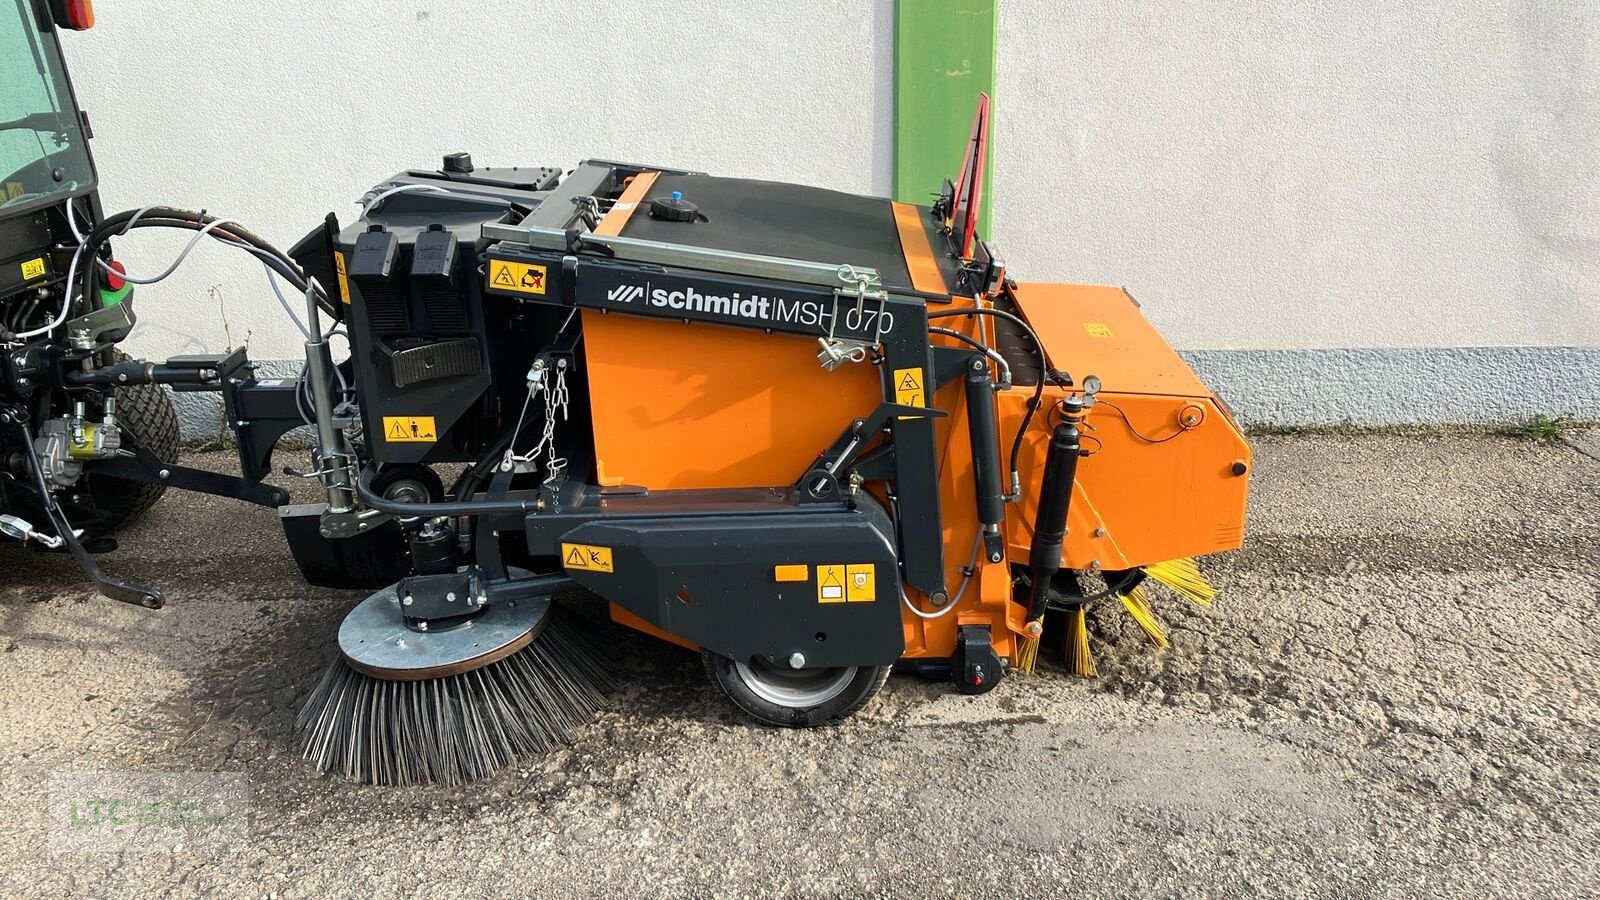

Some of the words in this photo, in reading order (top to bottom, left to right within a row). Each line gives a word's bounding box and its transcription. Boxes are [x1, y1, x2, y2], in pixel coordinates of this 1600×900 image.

[651, 287, 770, 320] schmidt
[776, 298, 837, 327] MSH
[846, 307, 894, 334] 070
